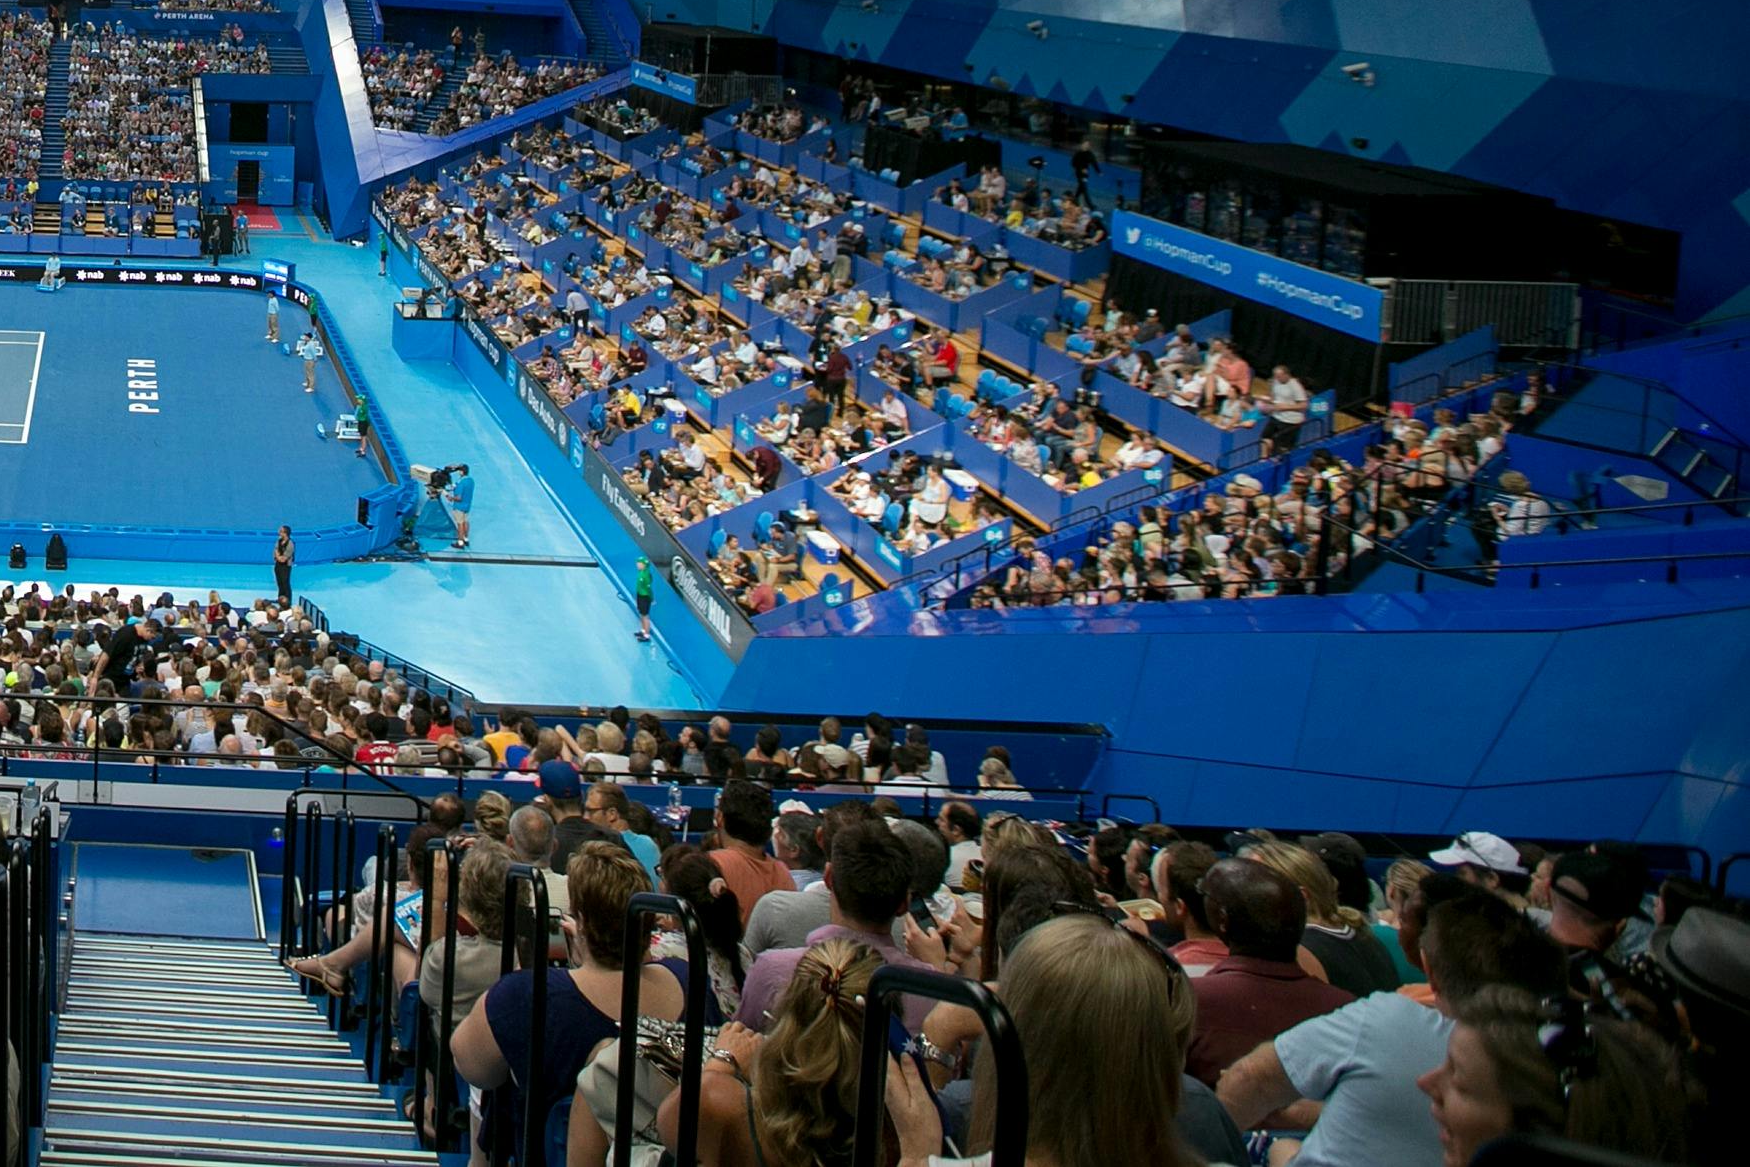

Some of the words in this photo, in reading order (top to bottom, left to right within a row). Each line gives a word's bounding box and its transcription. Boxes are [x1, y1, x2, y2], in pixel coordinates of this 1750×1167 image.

[162, 12, 187, 20] PERTH
[1143, 235, 1232, 276] @HopmanCup
[87, 270, 104, 280] nab
[130, 271, 146, 280] nab
[166, 272, 183, 282] nab
[204, 273, 221, 282] nab
[240, 276, 256, 286] nab
[1256, 272, 1365, 319] #HopmanCup
[468, 315, 488, 351] hopman
[489, 343, 500, 366] cup
[127, 359, 160, 413] PERTH
[602, 474, 615, 503] Fly
[615, 486, 646, 536] Emirates
[985, 530, 1003, 540] 84
[826, 593, 843, 604] 82
